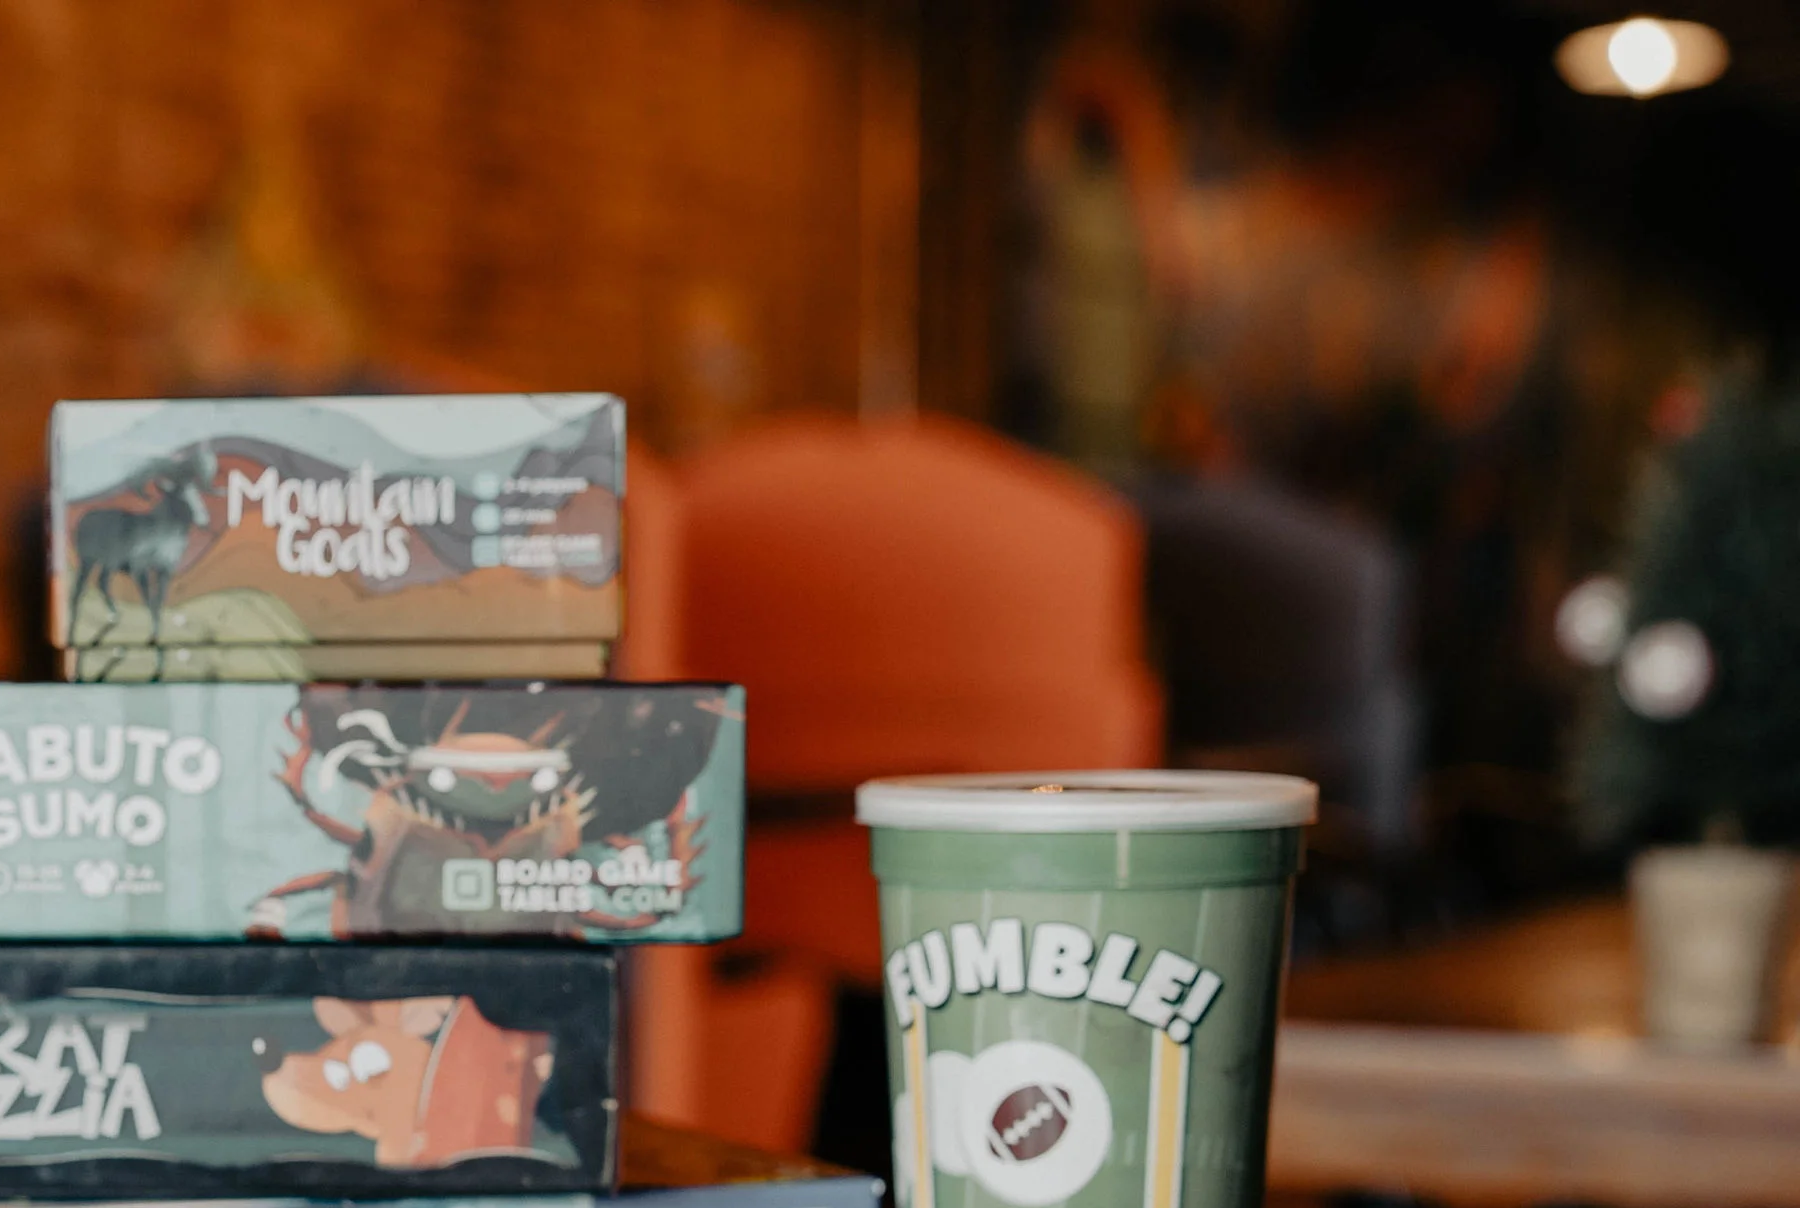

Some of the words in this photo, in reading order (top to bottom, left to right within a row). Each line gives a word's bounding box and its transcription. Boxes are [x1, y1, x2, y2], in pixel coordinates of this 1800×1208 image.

[226, 461, 456, 528] Mountain
[277, 514, 410, 578] Goats
[886, 917, 1225, 1043] FUMBLE!
